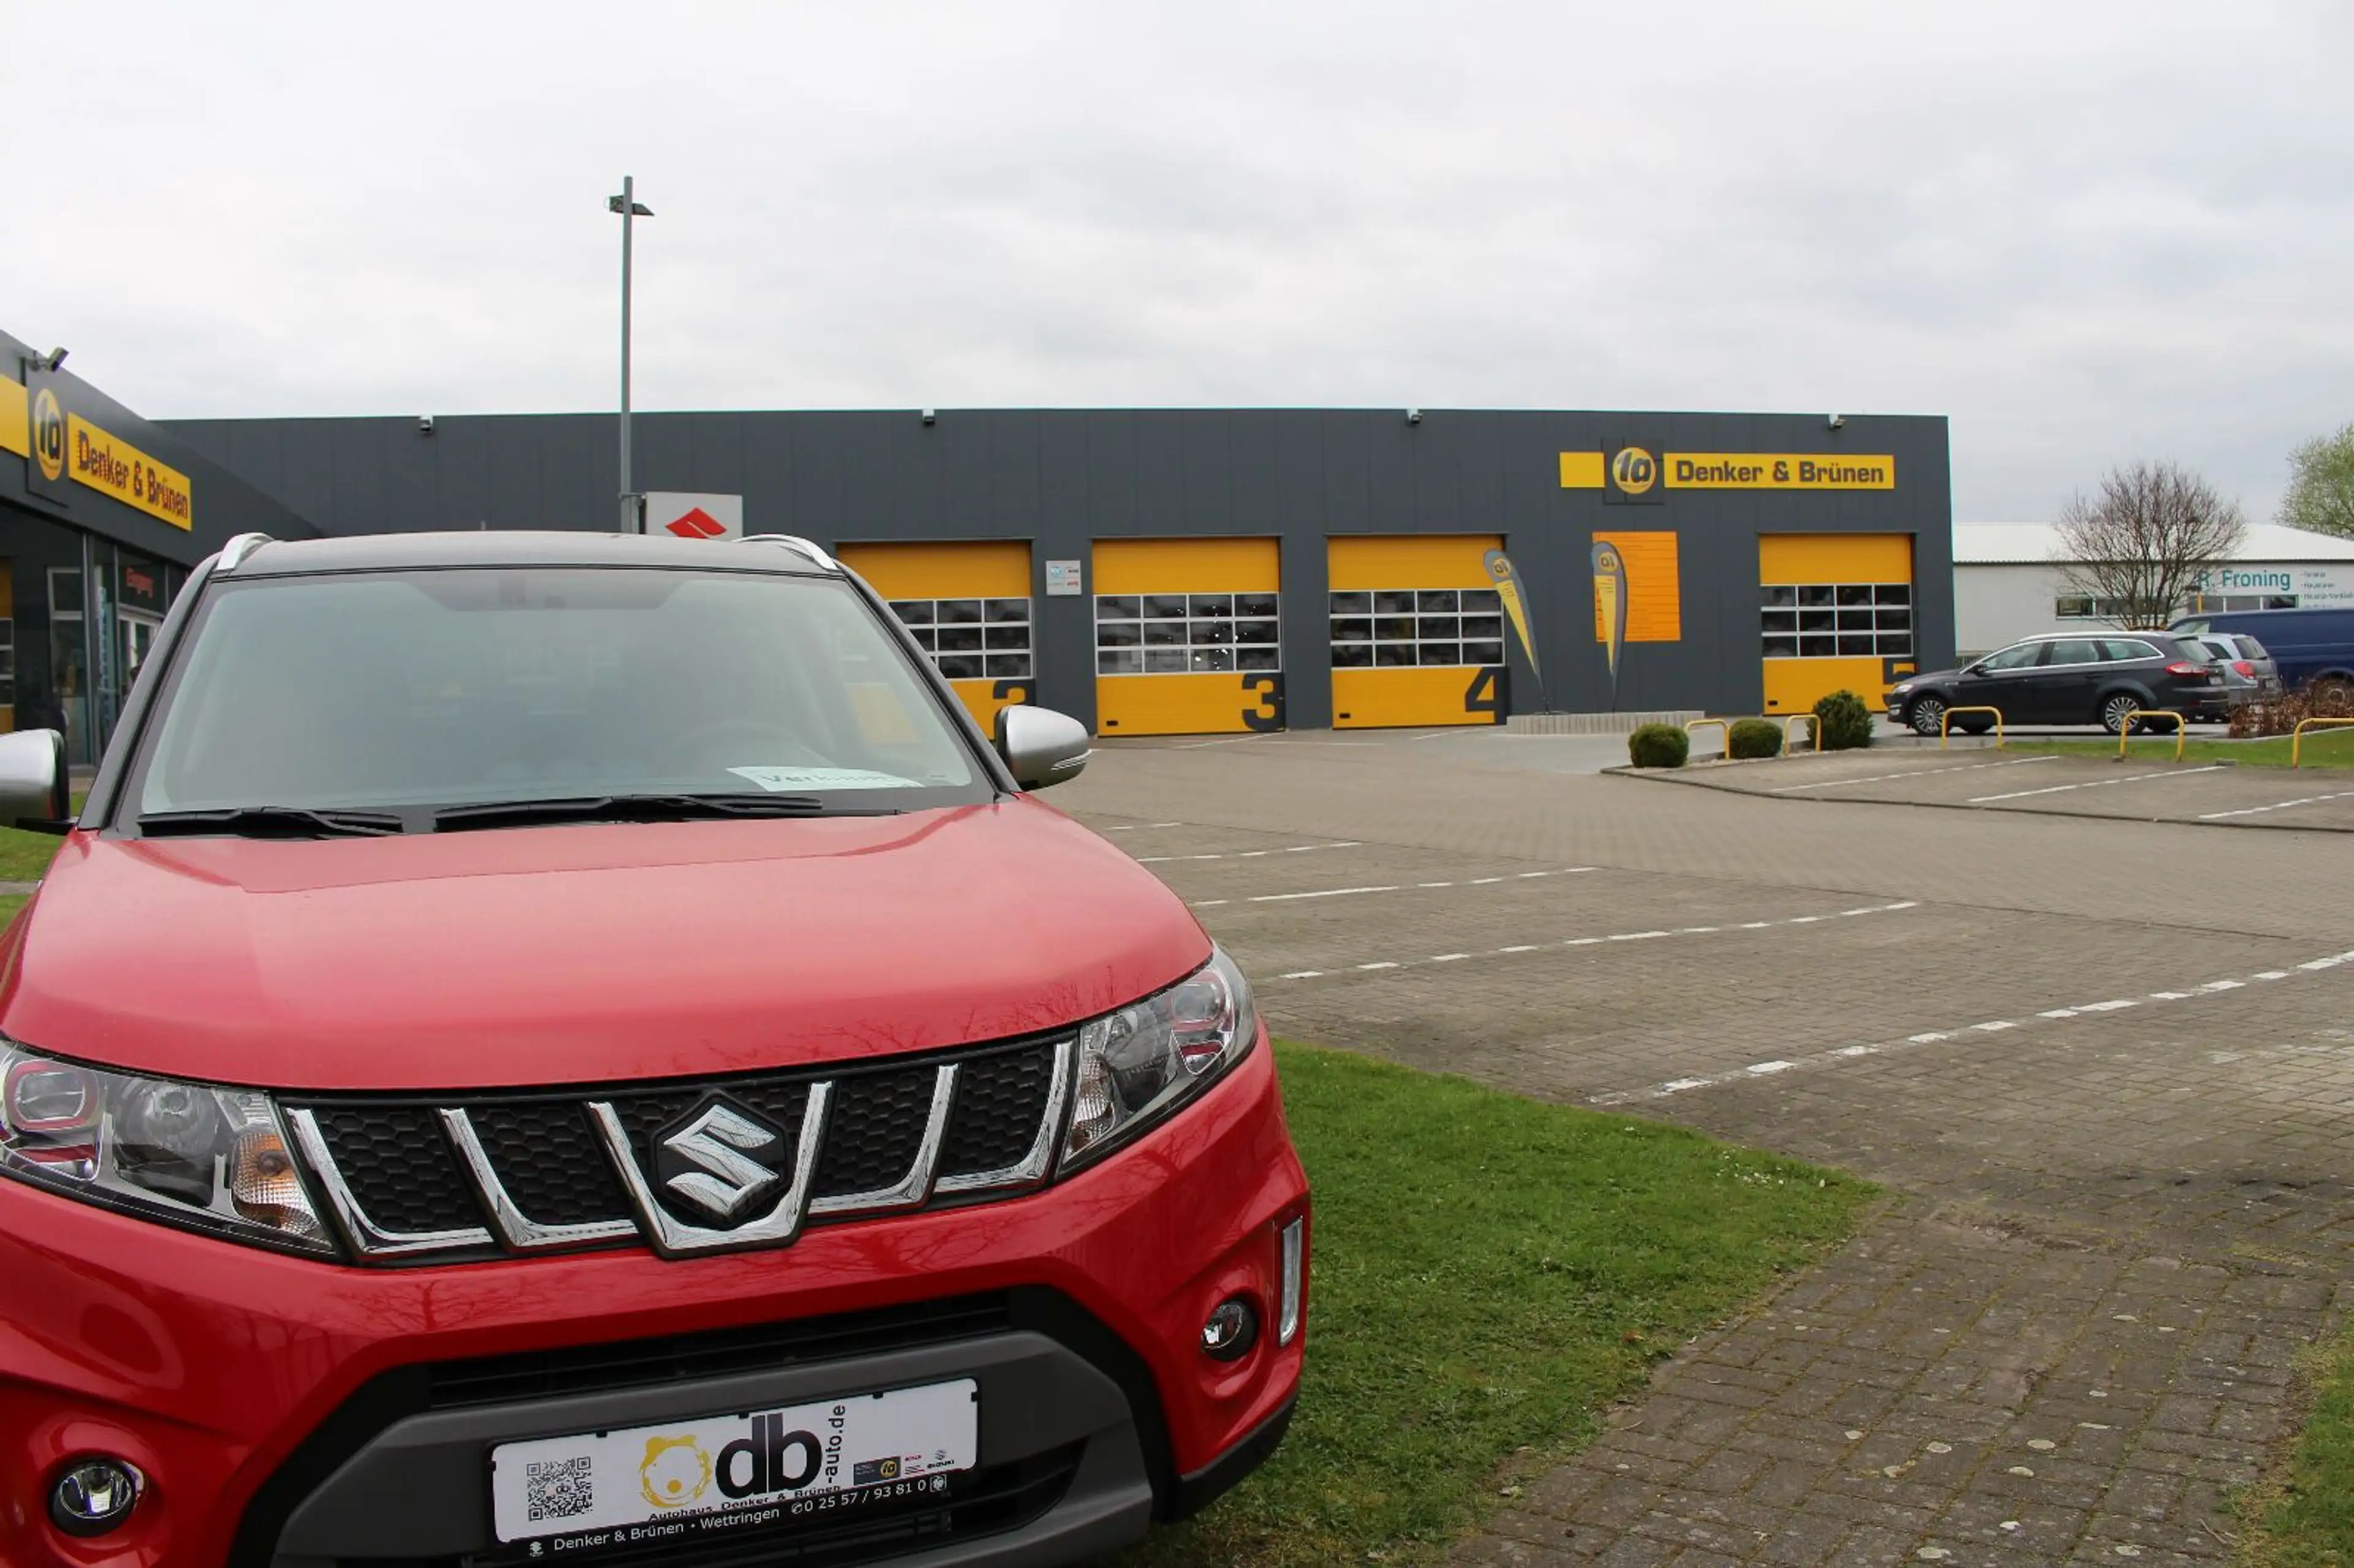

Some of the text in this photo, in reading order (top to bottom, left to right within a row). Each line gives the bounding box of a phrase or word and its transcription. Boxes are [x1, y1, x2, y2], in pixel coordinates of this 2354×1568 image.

[78, 428, 188, 519] Denker & Brünen
[1616, 451, 1651, 483] 1a
[1676, 460, 1884, 484] Denker & Brünen
[2222, 569, 2291, 591] Froning
[1241, 674, 1284, 731] 3
[1465, 666, 1507, 725] 4
[715, 1412, 823, 1499] db
[554, 1532, 609, 1550] Denker
[615, 1530, 626, 1542] &
[631, 1522, 684, 1540] Brünen
[700, 1508, 780, 1529] Wettringen
[818, 1496, 836, 1510] 25
[841, 1493, 858, 1506] 57
[874, 1486, 891, 1499] 93
[895, 1483, 912, 1496] 81
[918, 1479, 926, 1491] 0
[649, 1506, 713, 1521] Autohaus
[722, 1496, 769, 1510] Denker
[794, 1485, 840, 1498] Brünen
